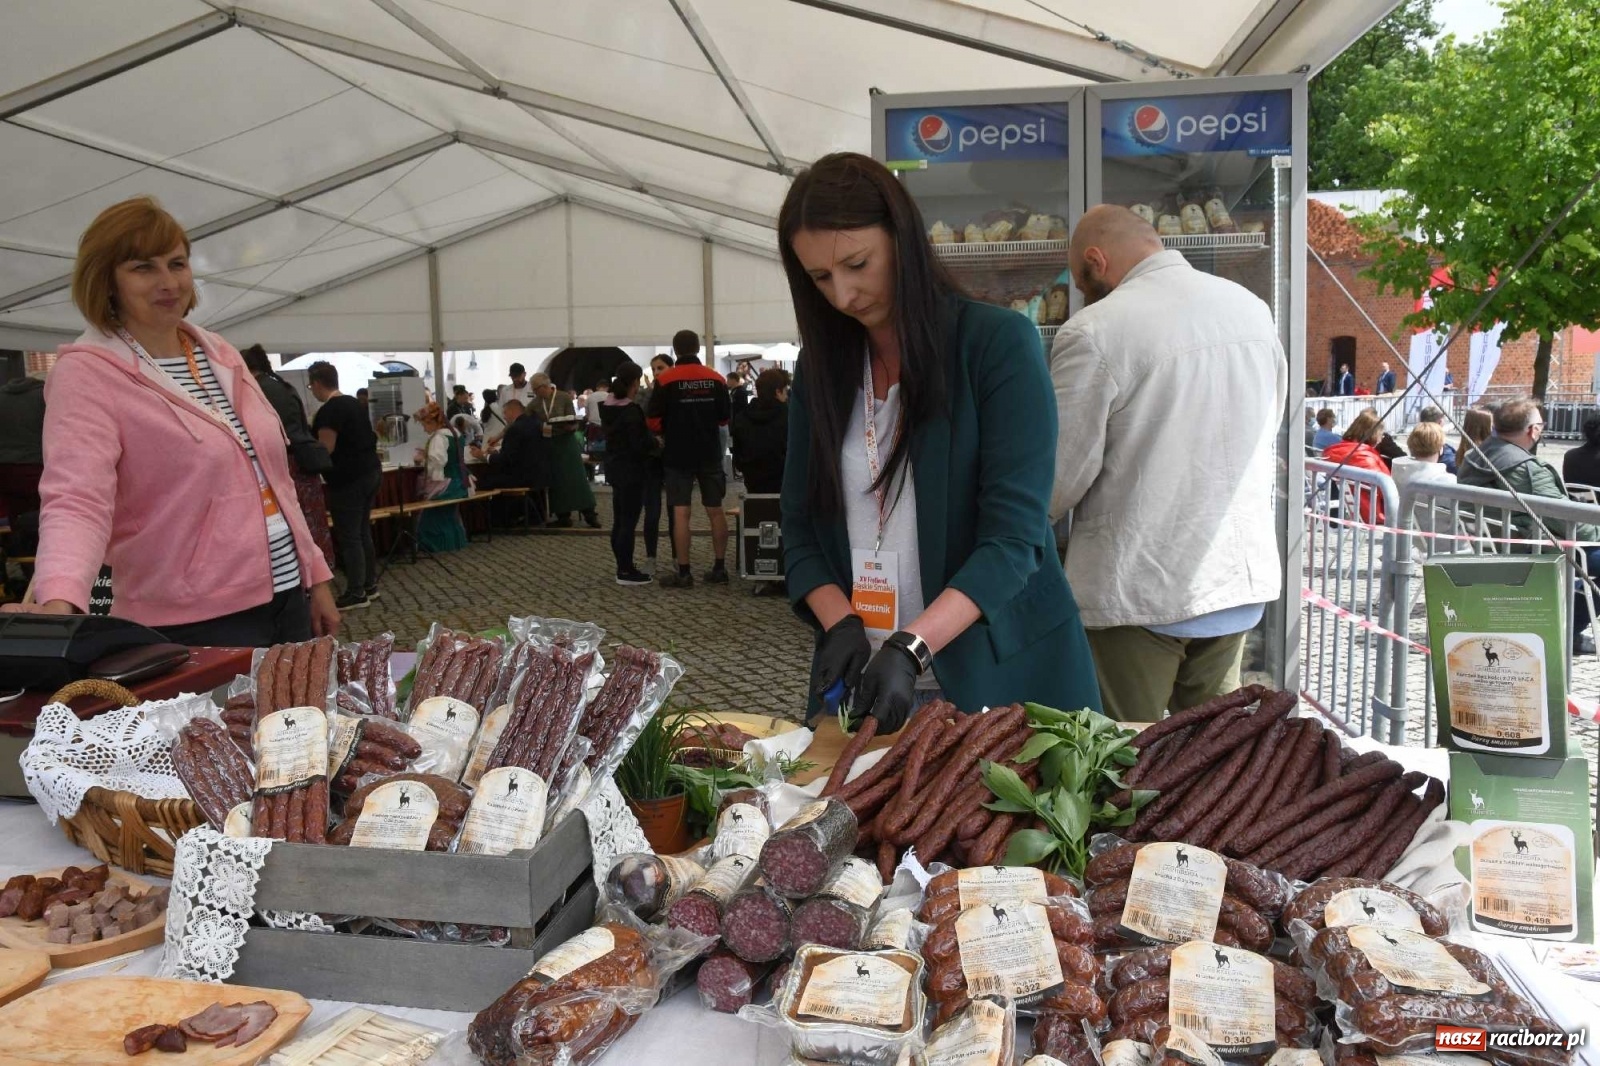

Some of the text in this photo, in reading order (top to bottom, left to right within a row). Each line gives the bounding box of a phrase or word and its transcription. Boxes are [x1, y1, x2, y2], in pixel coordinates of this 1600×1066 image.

[959, 117, 1045, 152] pepsi
[1177, 106, 1267, 142] pepsi
[95, 576, 112, 587] kie
[856, 602, 890, 613] Uczestnik
